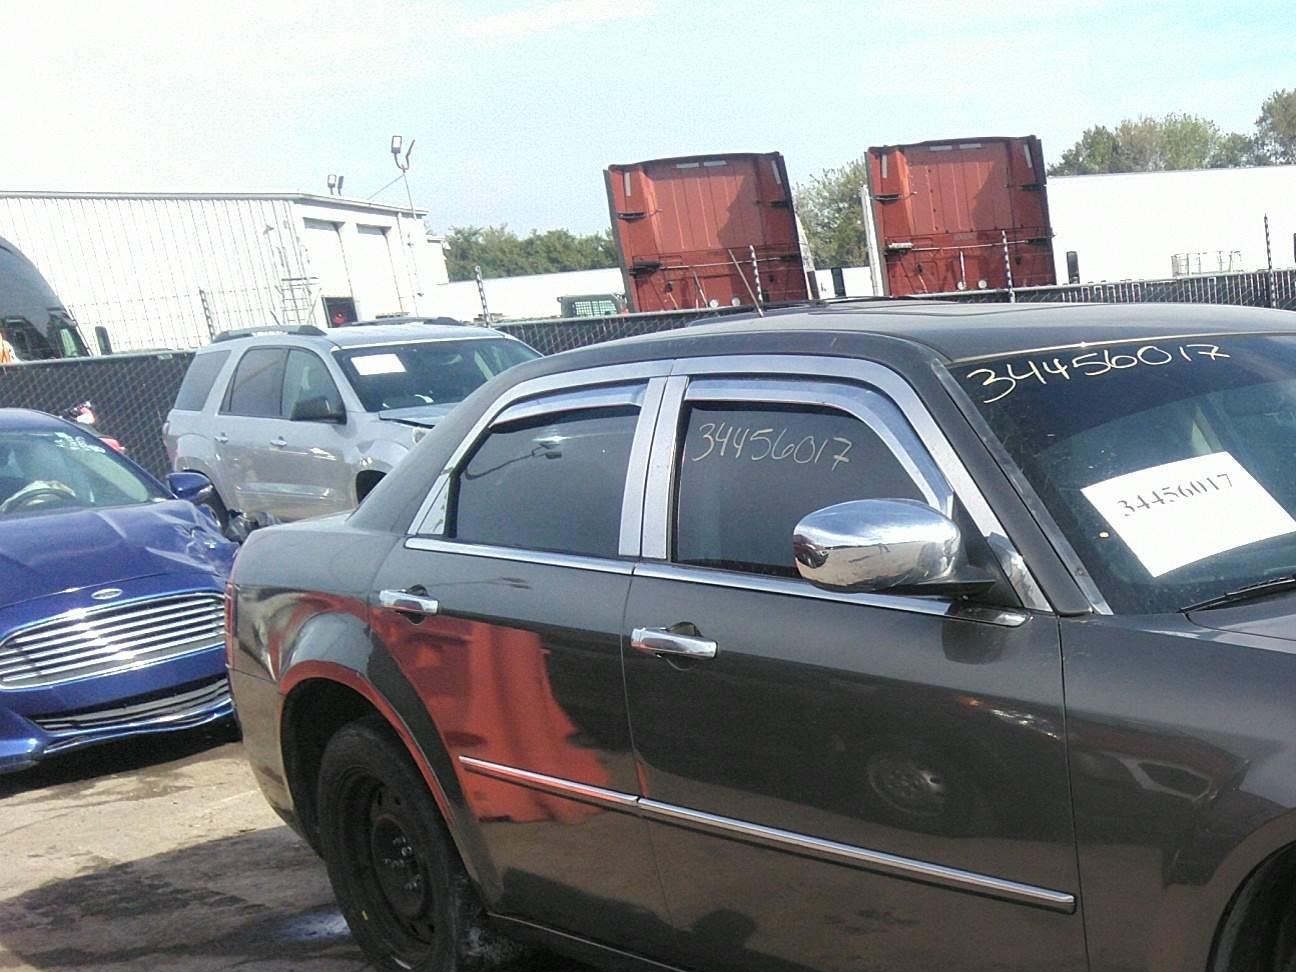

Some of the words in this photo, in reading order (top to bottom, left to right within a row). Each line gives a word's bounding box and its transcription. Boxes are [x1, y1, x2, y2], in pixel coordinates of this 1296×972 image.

[966, 345, 1231, 404] 34456017
[691, 422, 853, 472] 34456017
[1117, 473, 1233, 517] 34456017
